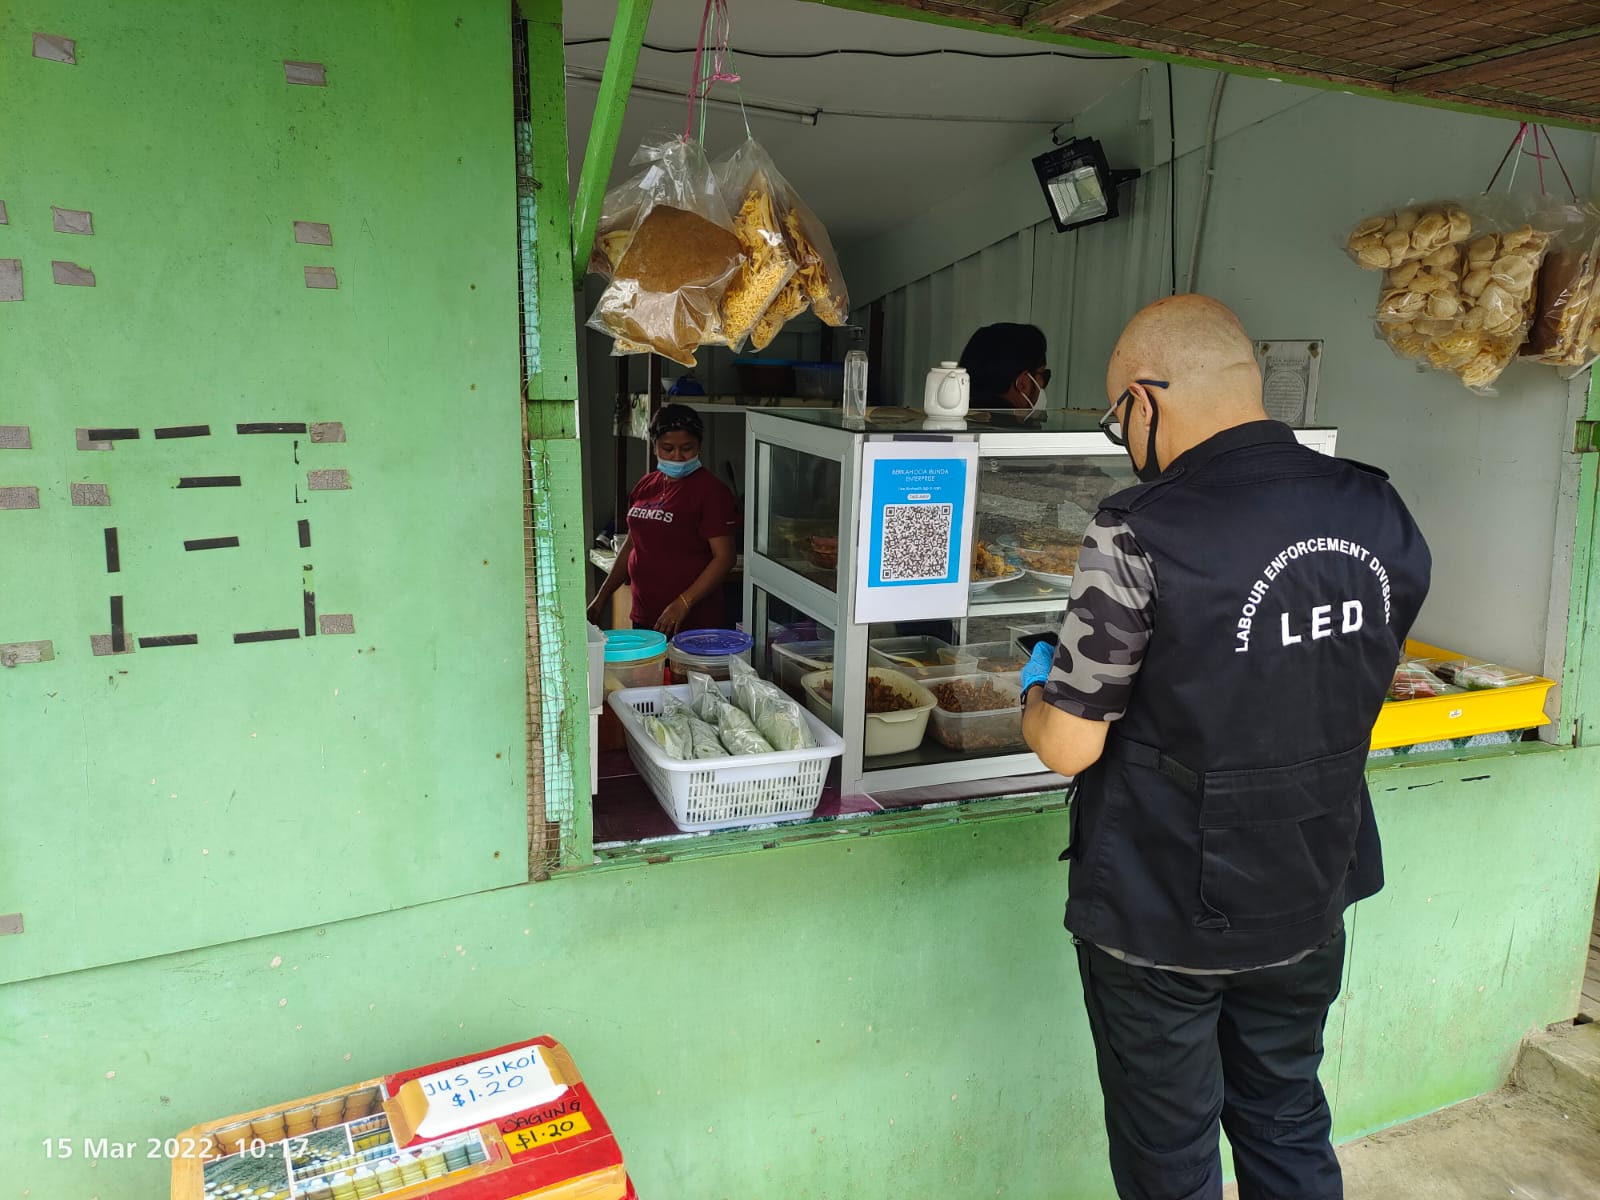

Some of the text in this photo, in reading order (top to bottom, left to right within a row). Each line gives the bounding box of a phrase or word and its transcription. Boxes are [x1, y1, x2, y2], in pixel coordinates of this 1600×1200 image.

[1235, 580, 1269, 652] LABOUR
[1264, 537, 1370, 581] ENFORCEMENT
[1280, 600, 1363, 646] LED
[424, 1073, 469, 1096] JUS
[451, 1074, 524, 1107] $1.20
[515, 1120, 574, 1149] $1.20
